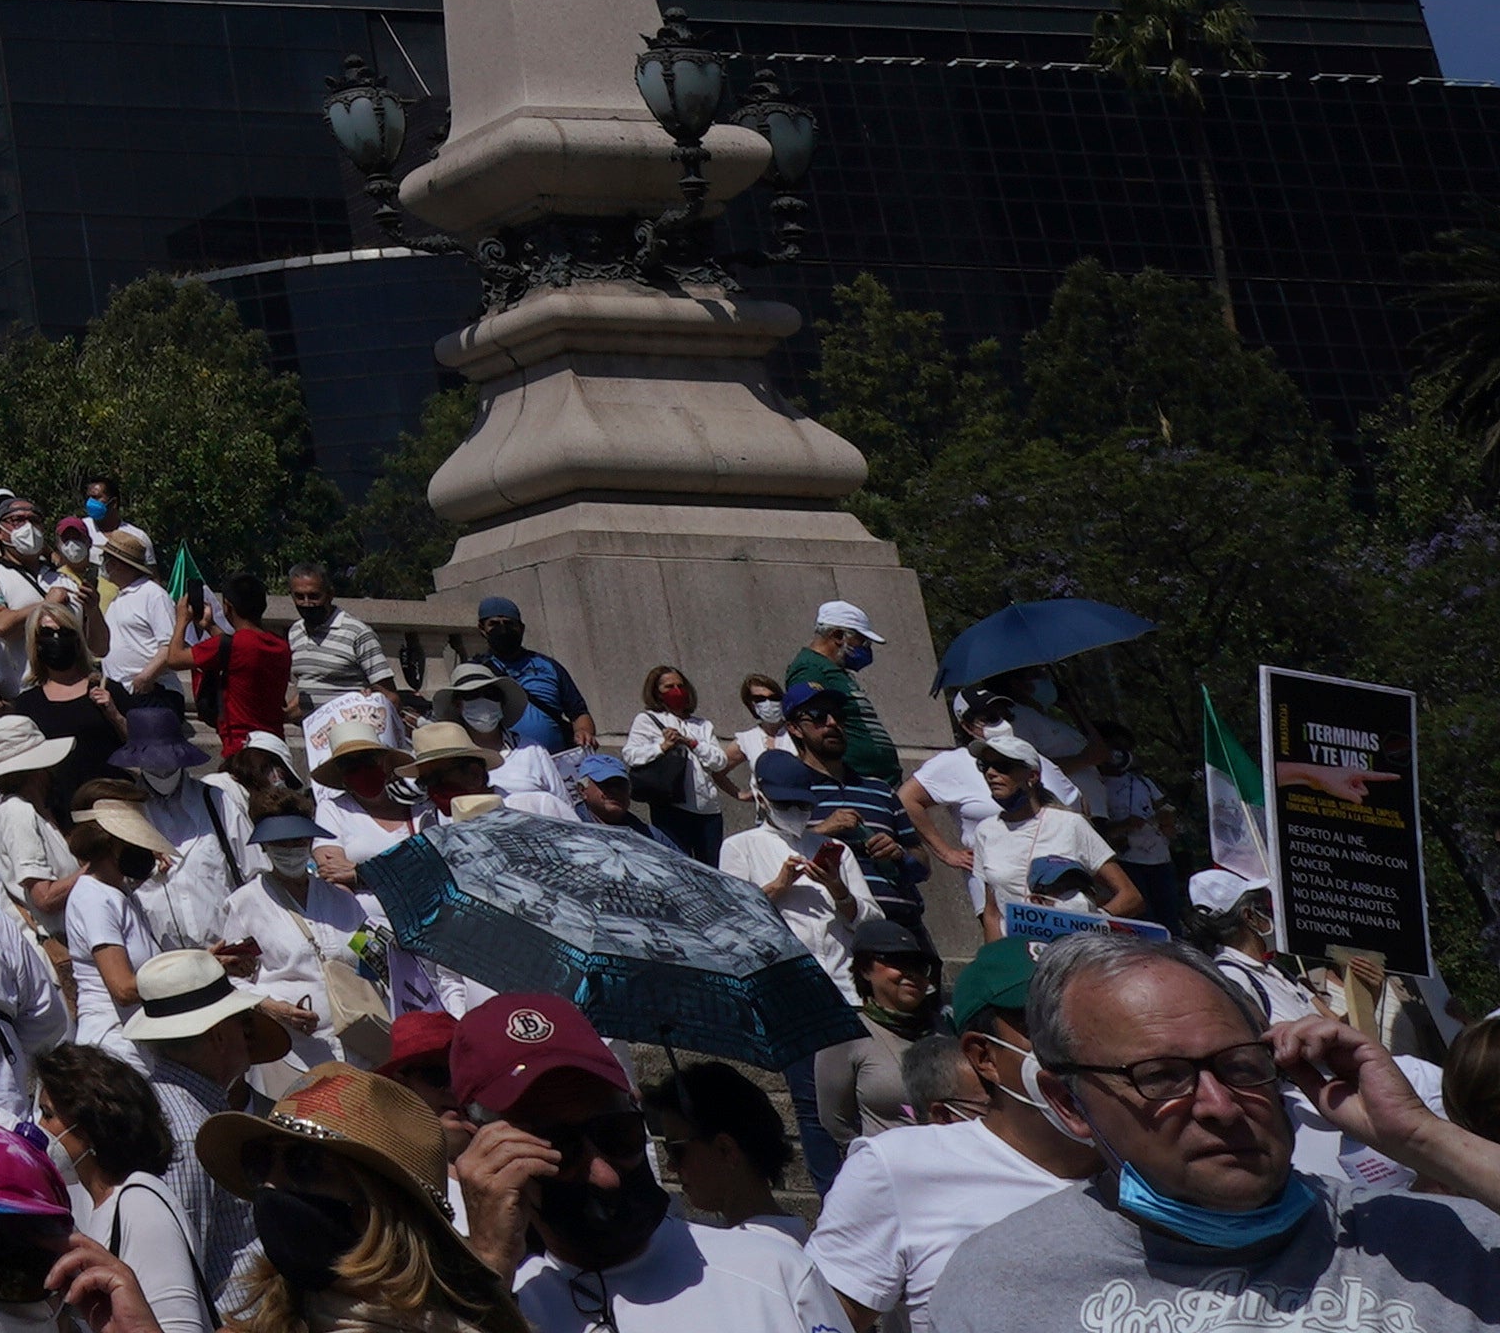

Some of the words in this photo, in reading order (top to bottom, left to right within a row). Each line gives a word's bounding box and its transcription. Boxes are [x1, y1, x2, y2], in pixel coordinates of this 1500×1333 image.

[1301, 721, 1380, 752] ¡TERMINAS
[1309, 743, 1318, 763] Y
[1321, 747, 1339, 766] TE
[1287, 824, 1331, 842] RESPETO
[1332, 832, 1345, 843] AL
[1341, 849, 1349, 860] A
[1350, 850, 1383, 866] NIÑOS
[1385, 857, 1409, 870] CON
[1291, 871, 1308, 884] NO
[1309, 874, 1335, 888] TALA
[1336, 880, 1350, 890] DE
[1292, 887, 1309, 899] NO
[1310, 889, 1347, 906] DAÑAR
[1013, 908, 1049, 924] HOY
[1053, 918, 1067, 928] EL
[1294, 903, 1311, 915] NO
[1312, 905, 1349, 921] DAÑAR
[1350, 911, 1386, 929] FAUNA
[1386, 919, 1402, 931] EN
[1012, 923, 1053, 938] JUEGO
[1177, 1268, 1426, 1333] Angeles
